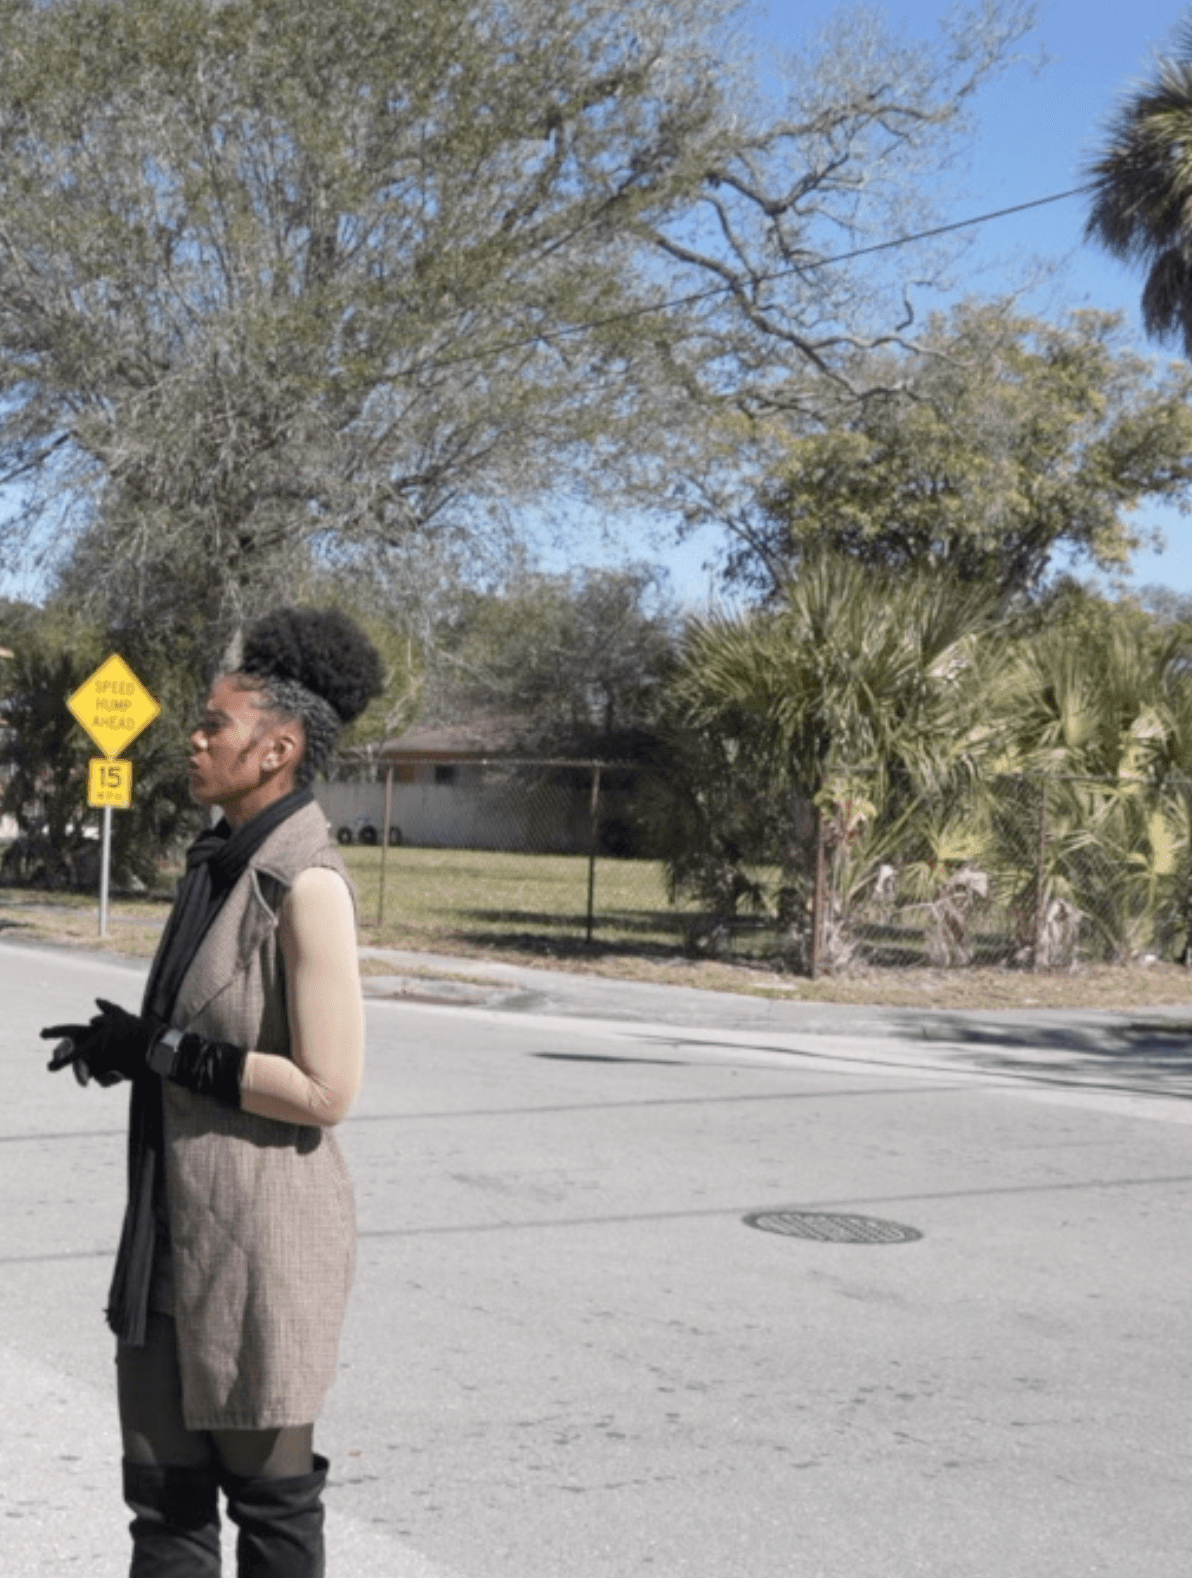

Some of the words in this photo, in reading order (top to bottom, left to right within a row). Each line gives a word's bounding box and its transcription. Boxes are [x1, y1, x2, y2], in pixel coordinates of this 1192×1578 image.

[95, 680, 135, 695] SPEED
[96, 696, 132, 711] HUMP
[93, 715, 135, 730] AHEAD
[98, 765, 122, 789] 15
